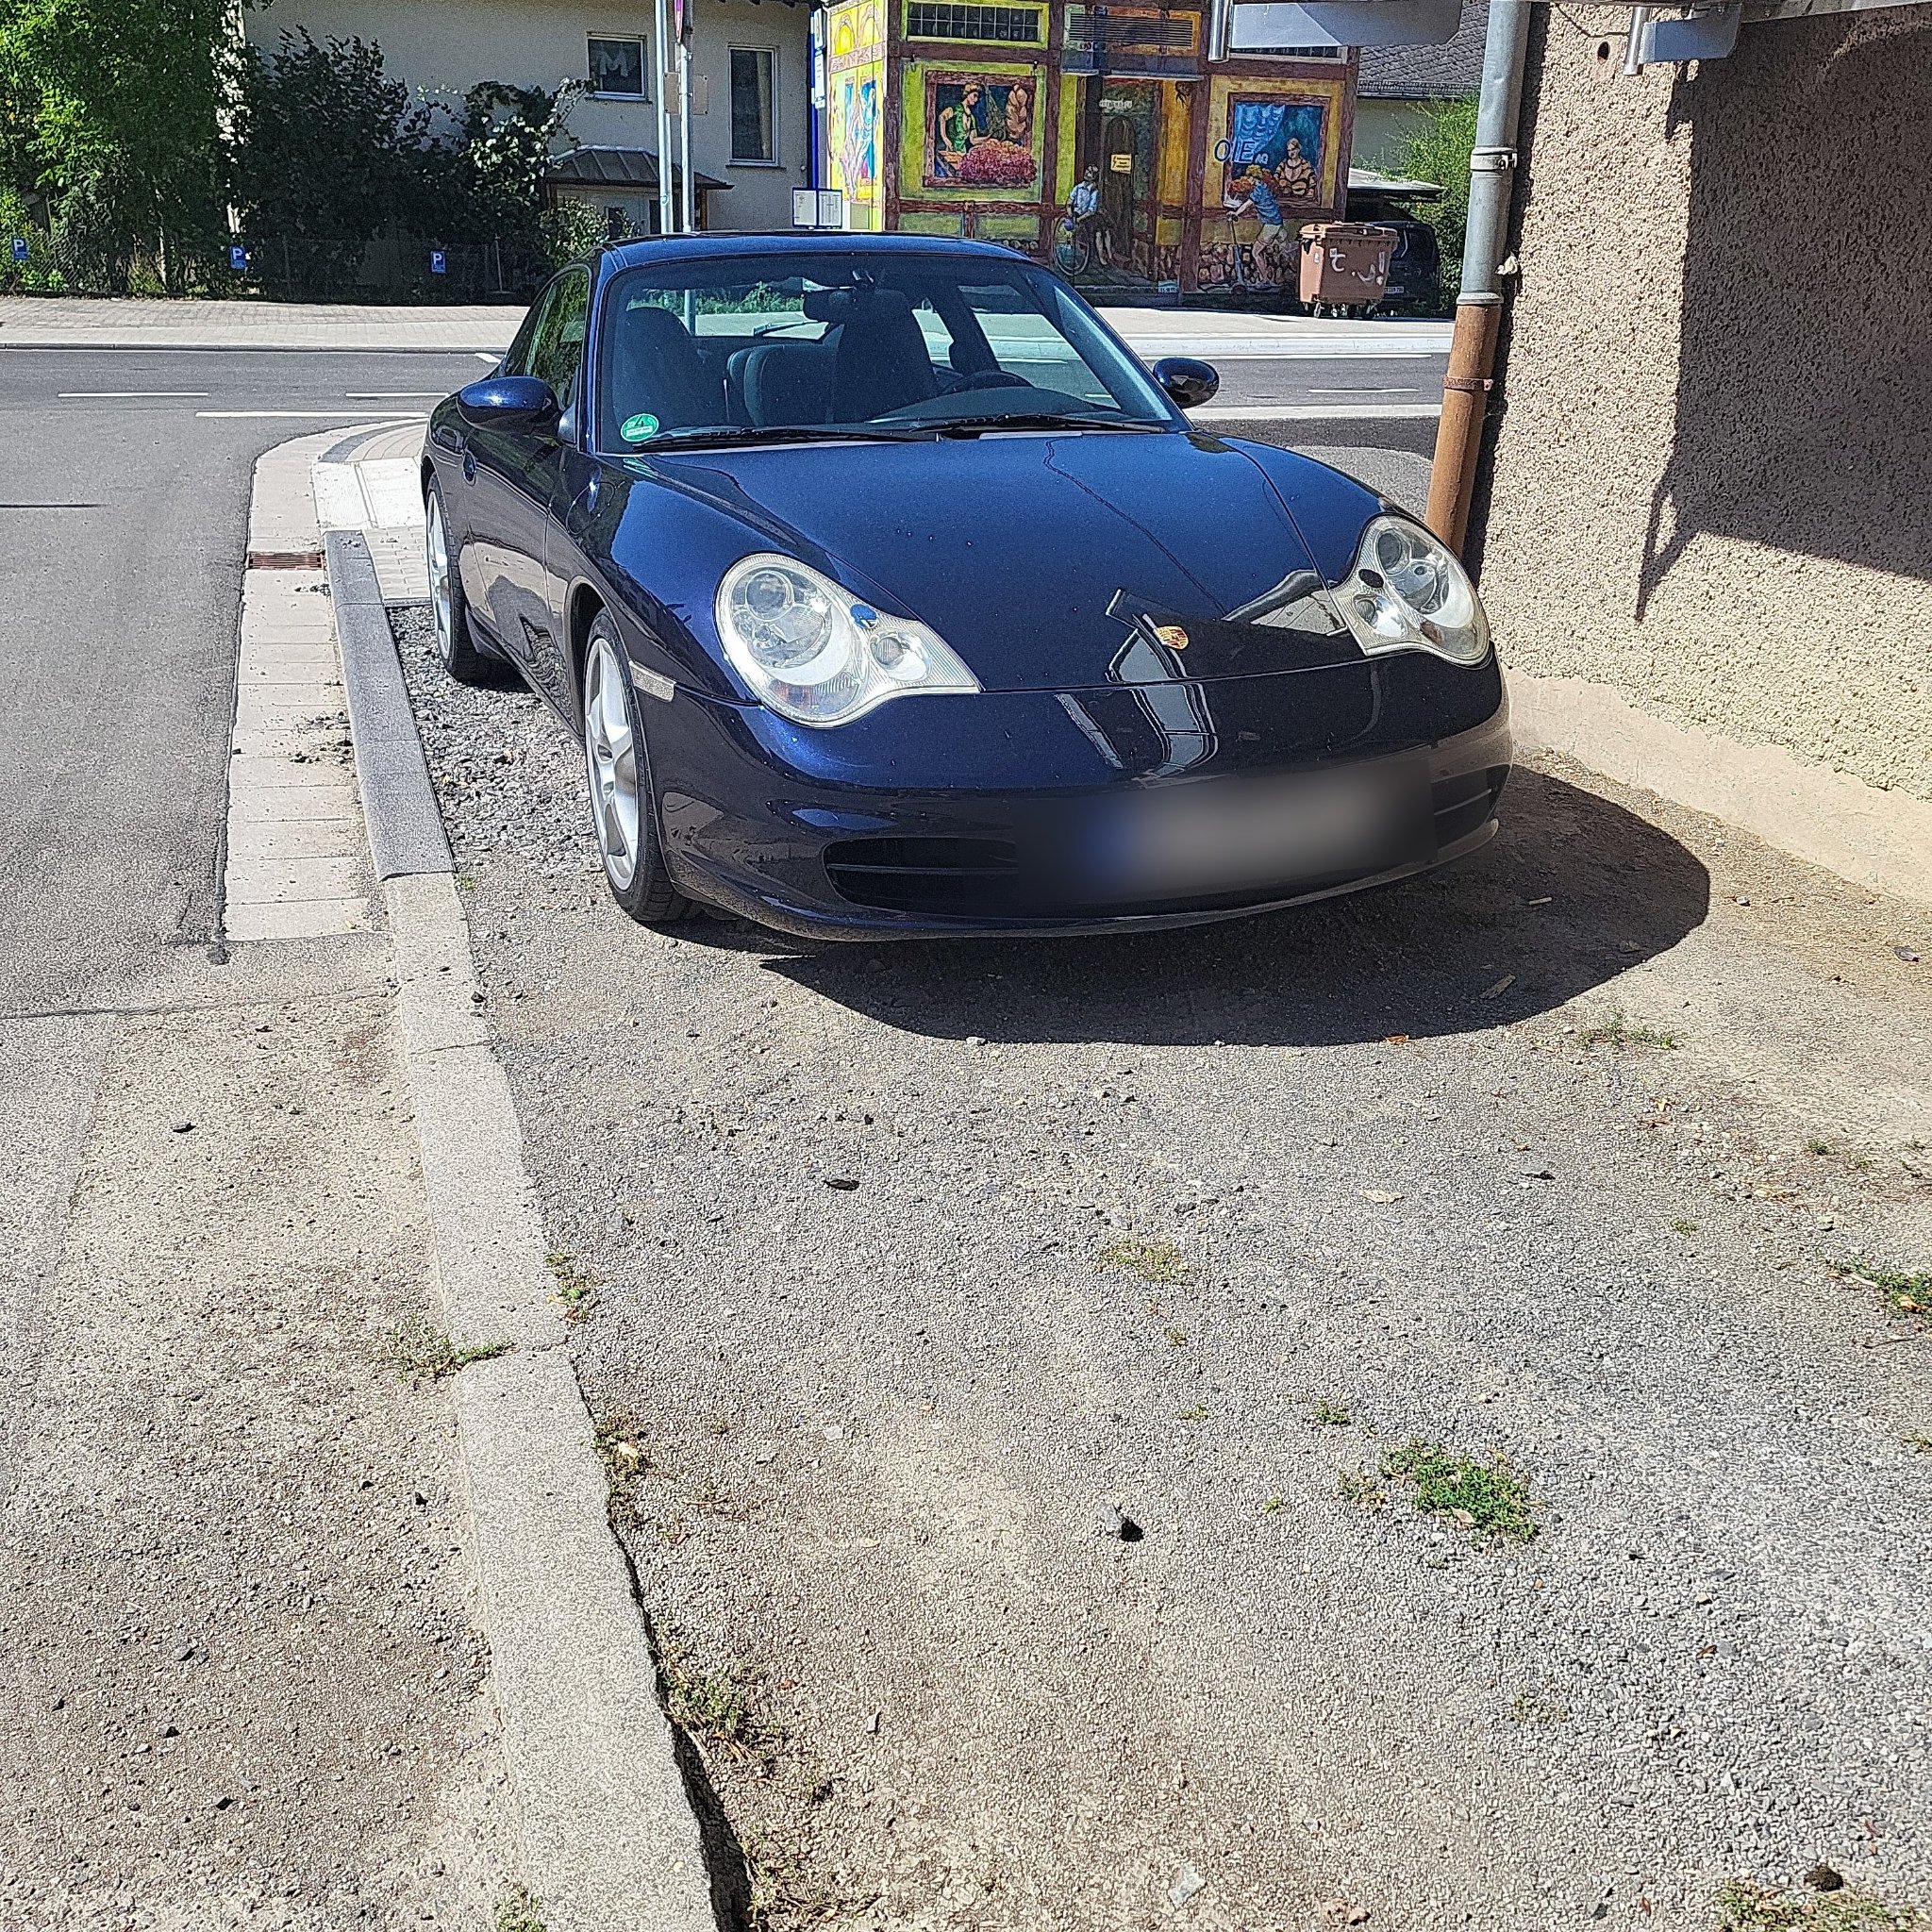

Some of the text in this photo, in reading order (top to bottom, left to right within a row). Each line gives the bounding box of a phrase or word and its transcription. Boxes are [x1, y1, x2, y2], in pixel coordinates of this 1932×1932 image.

[13, 239, 25, 251] P
[232, 248, 243, 260] P
[433, 253, 442, 265] P
[634, 415, 645, 427] 4
